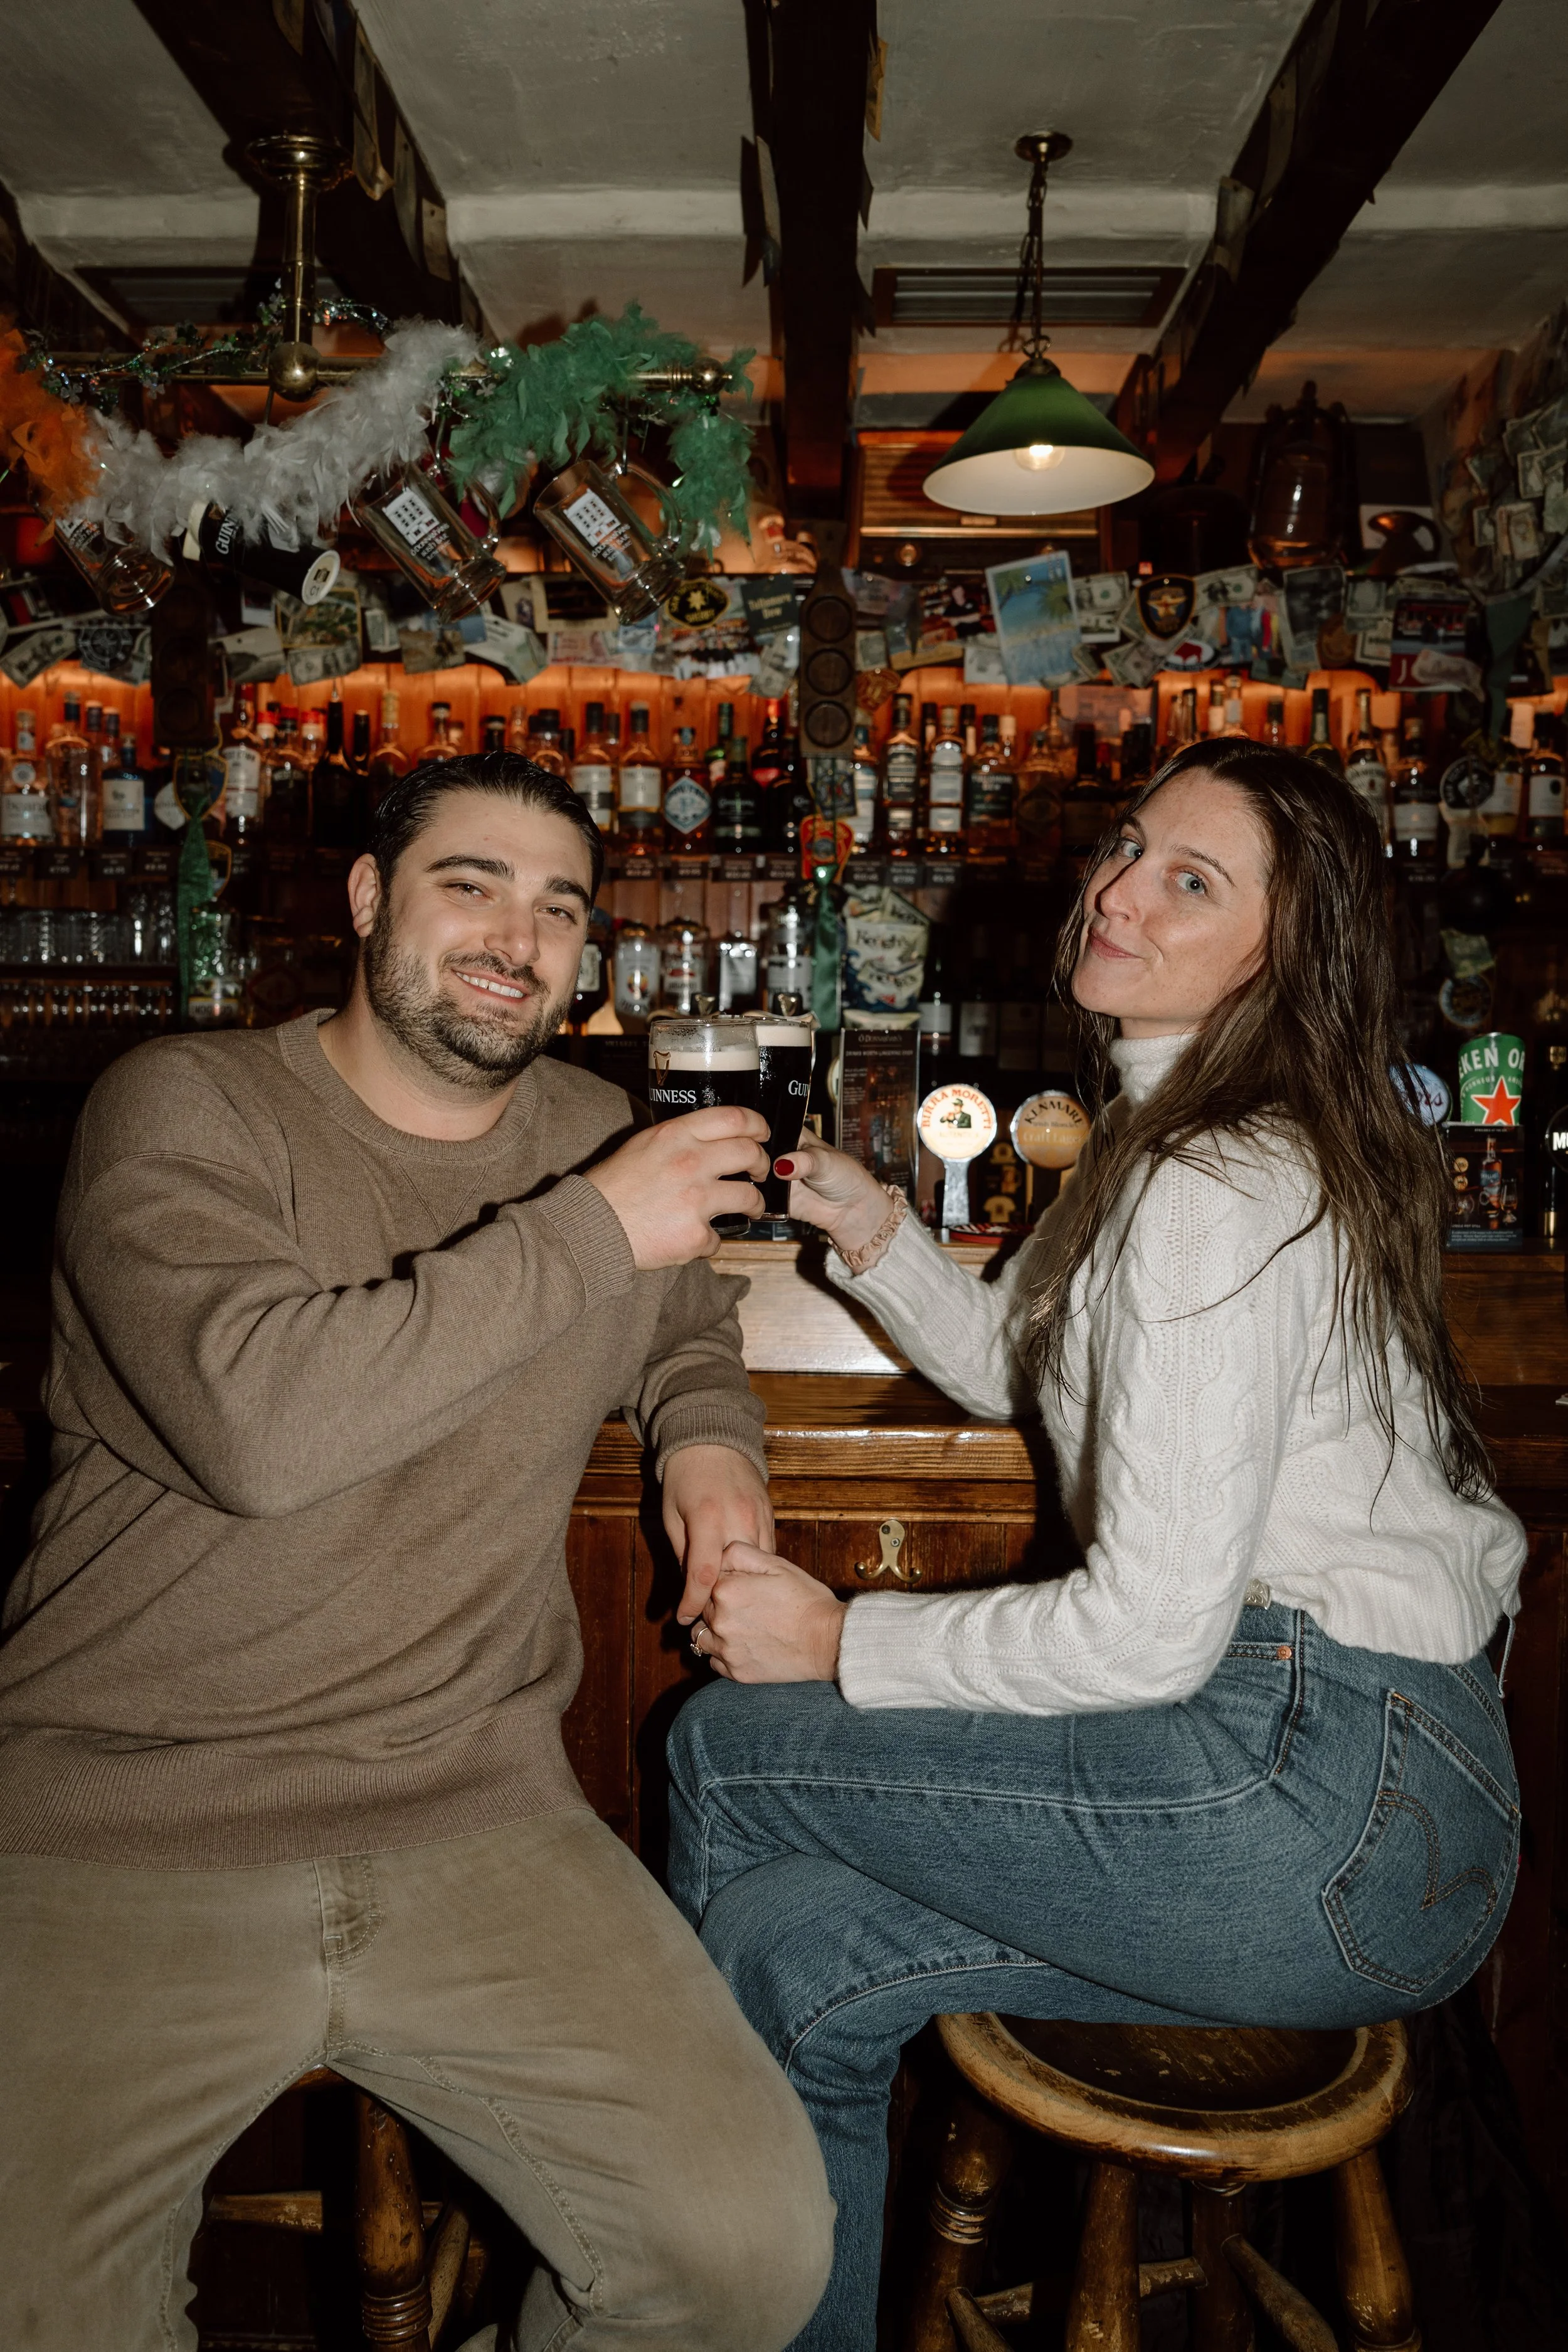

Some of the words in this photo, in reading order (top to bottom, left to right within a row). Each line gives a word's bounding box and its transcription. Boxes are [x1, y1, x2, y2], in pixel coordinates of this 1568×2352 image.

[649, 1088, 697, 1104] UINNESS
[922, 1091, 949, 1128] BIRRA
[951, 1089, 992, 1129] MORETTI
[1024, 1101, 1083, 1124] KENMARE
[1023, 1131, 1050, 1143] Craft
